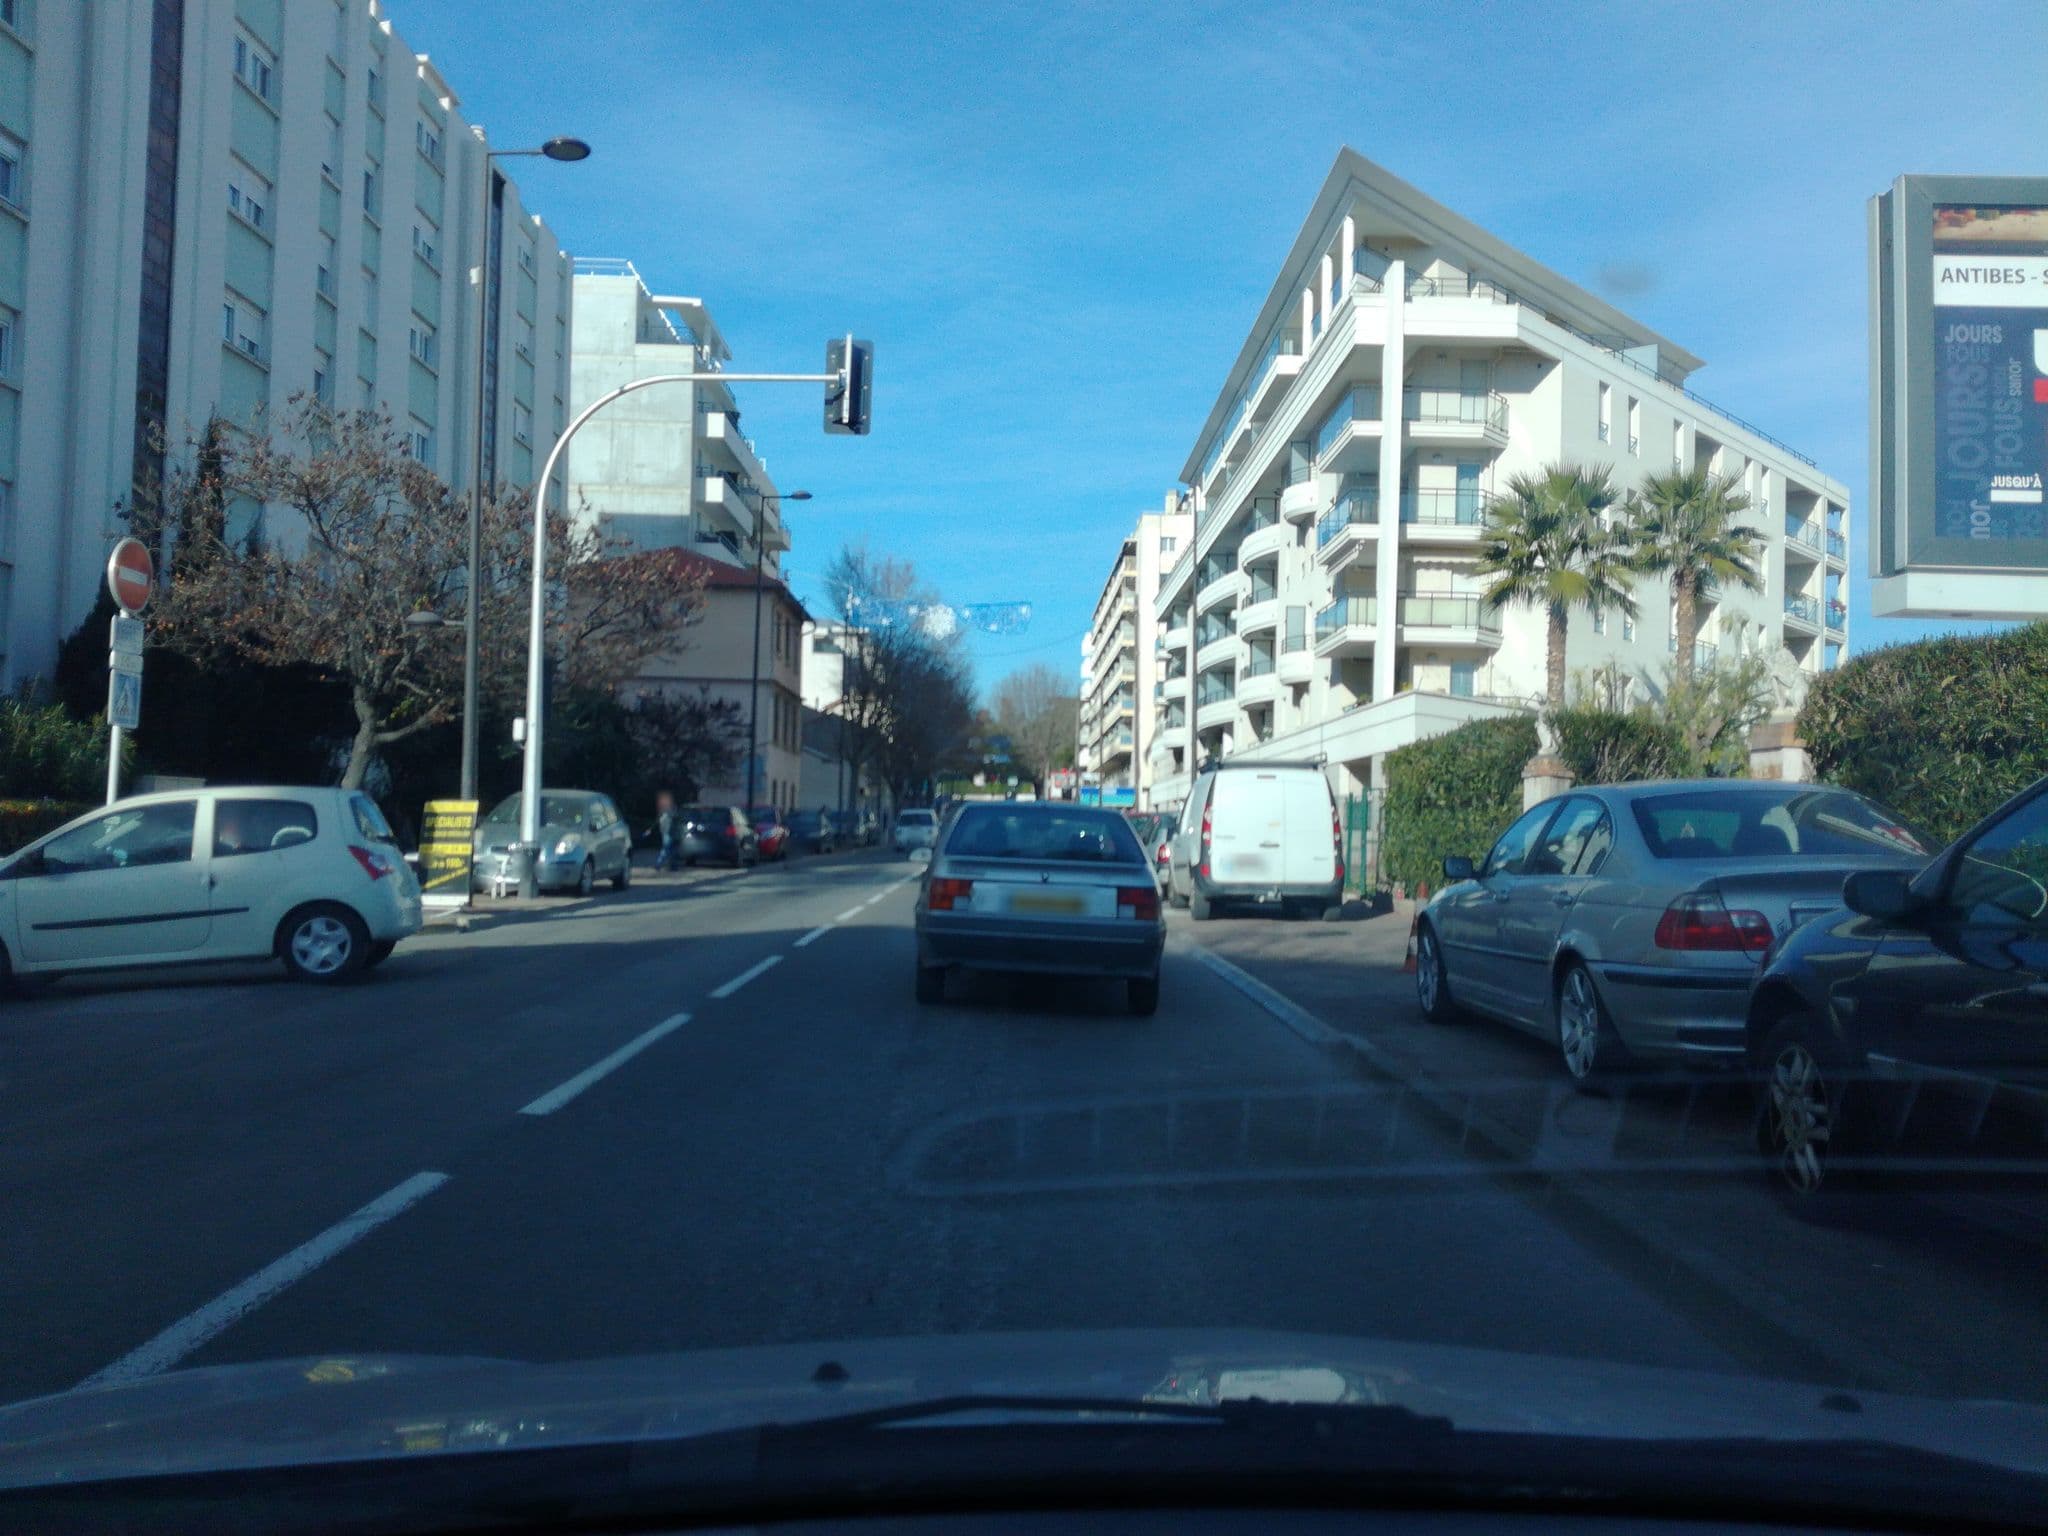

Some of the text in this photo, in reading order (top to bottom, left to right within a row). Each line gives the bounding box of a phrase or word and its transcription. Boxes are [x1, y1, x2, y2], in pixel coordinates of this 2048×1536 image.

[1941, 267, 2026, 284] ANTIBES
[1945, 324, 2003, 344] JOURS
[2008, 357, 2022, 396] JOURS
[1993, 398, 2023, 468] FOUS
[1991, 472, 2042, 489] JUSQU'À
